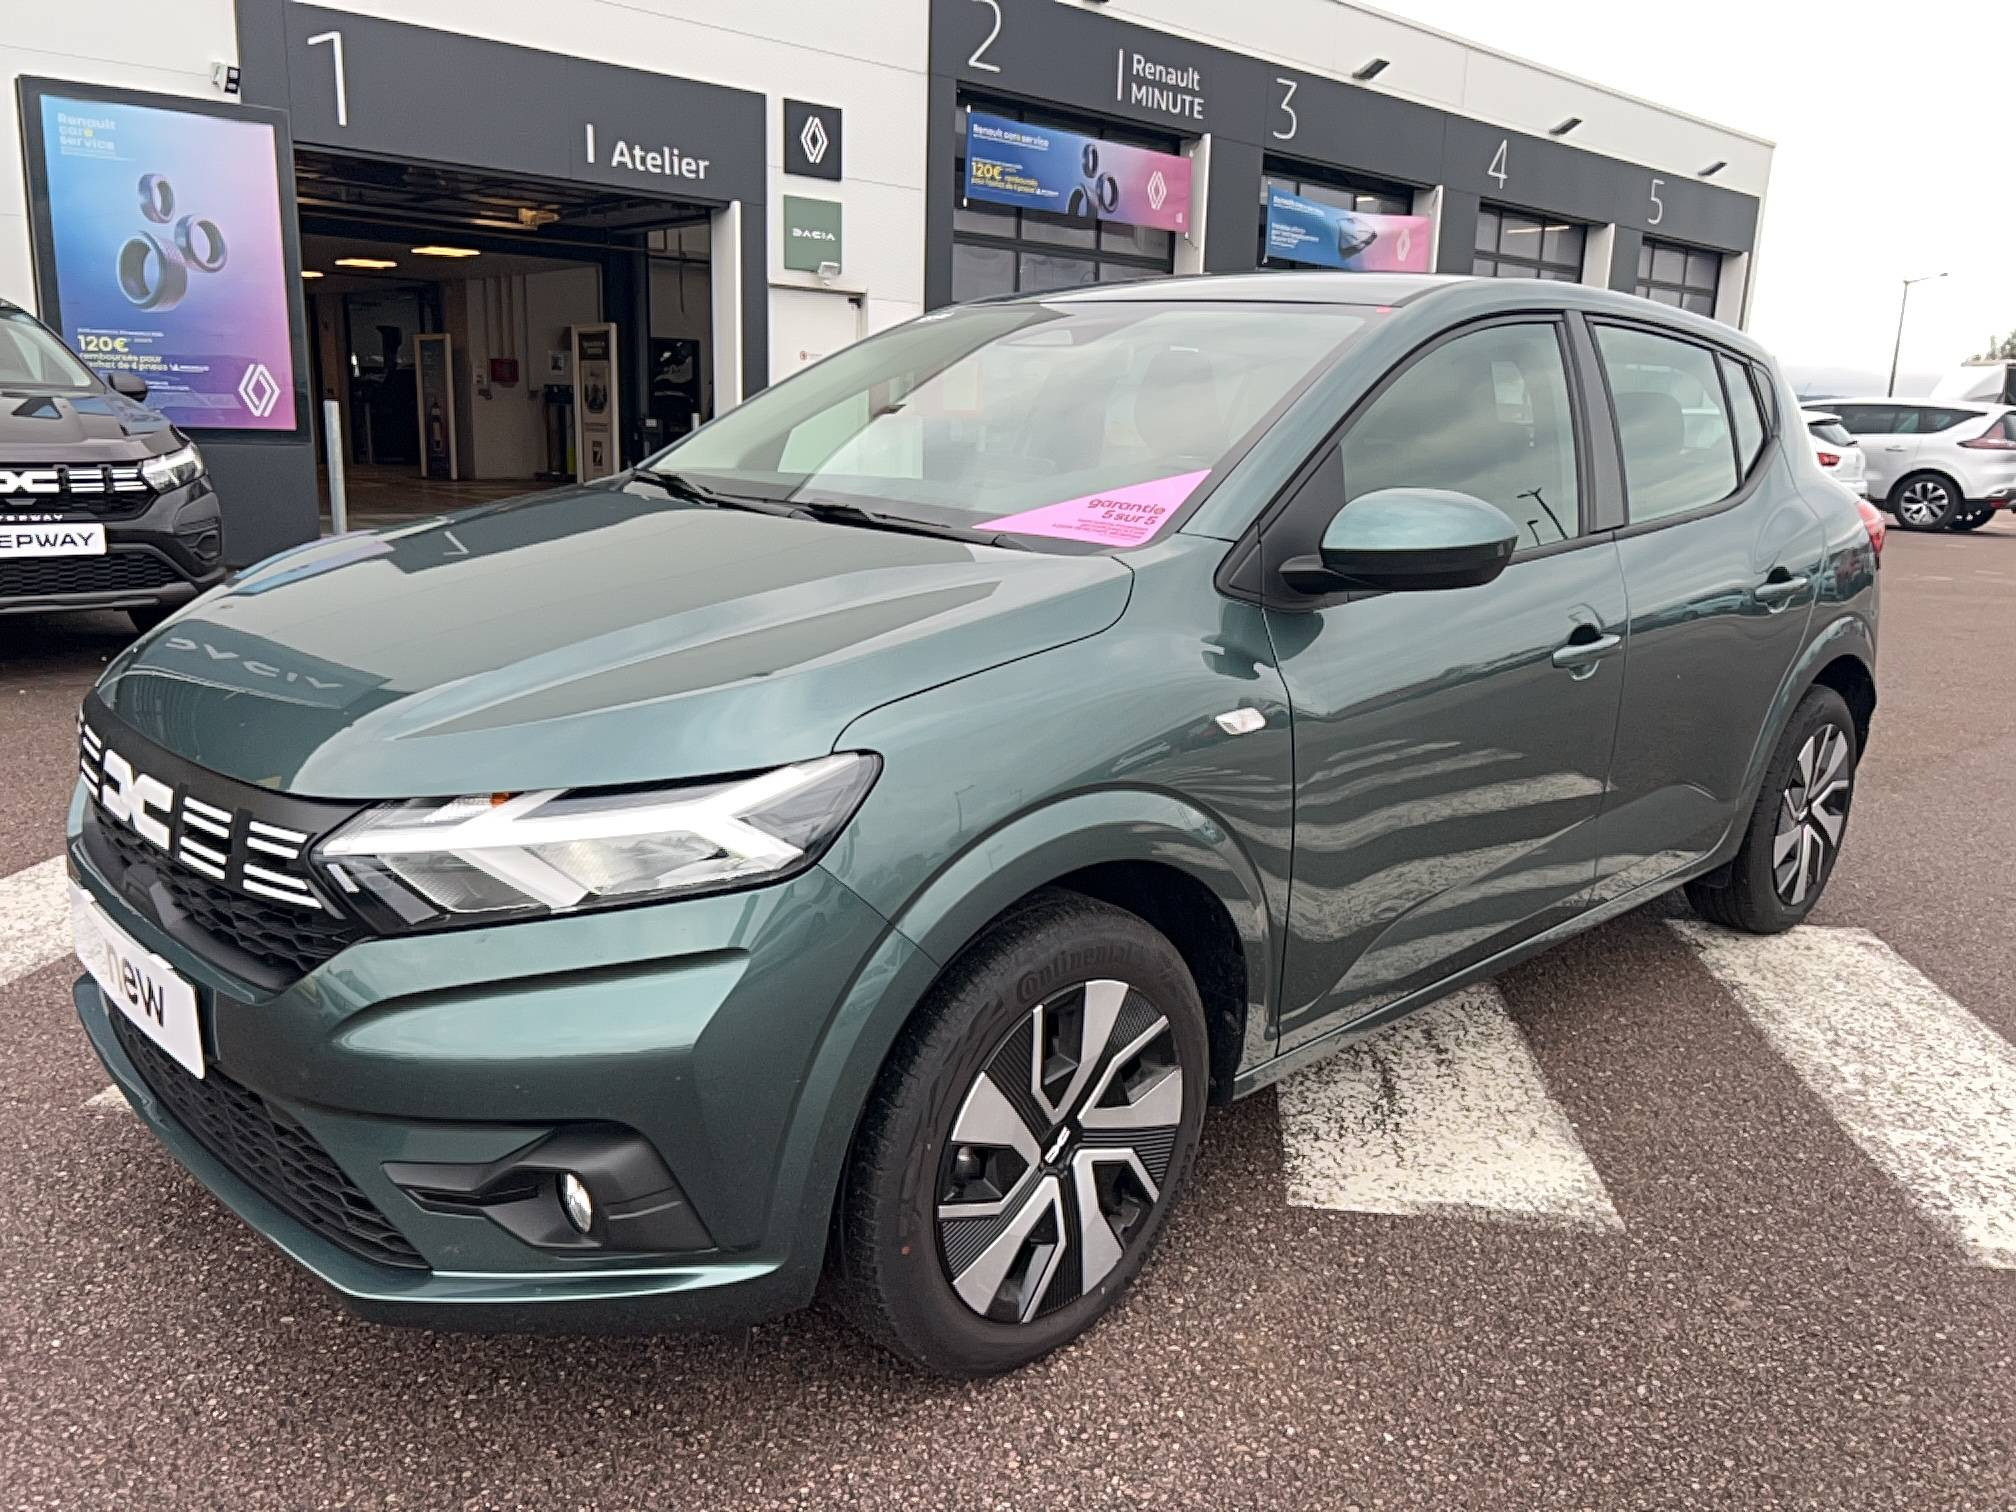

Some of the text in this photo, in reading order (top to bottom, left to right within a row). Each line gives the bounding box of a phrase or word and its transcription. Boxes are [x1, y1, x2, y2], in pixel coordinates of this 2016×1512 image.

[968, 0, 1001, 72] 2
[307, 31, 347, 126] 1
[1132, 53, 1201, 92] Renault
[58, 112, 116, 129] Renault
[1131, 82, 1205, 120] MINUTE
[1272, 77, 1298, 140] 3
[611, 140, 710, 180] Atelier
[1487, 139, 1508, 190] 4
[1647, 178, 1665, 226] 5
[792, 228, 836, 241] DACIA
[1088, 498, 1166, 515] garantie
[1102, 510, 1160, 526] 5 sur 5
